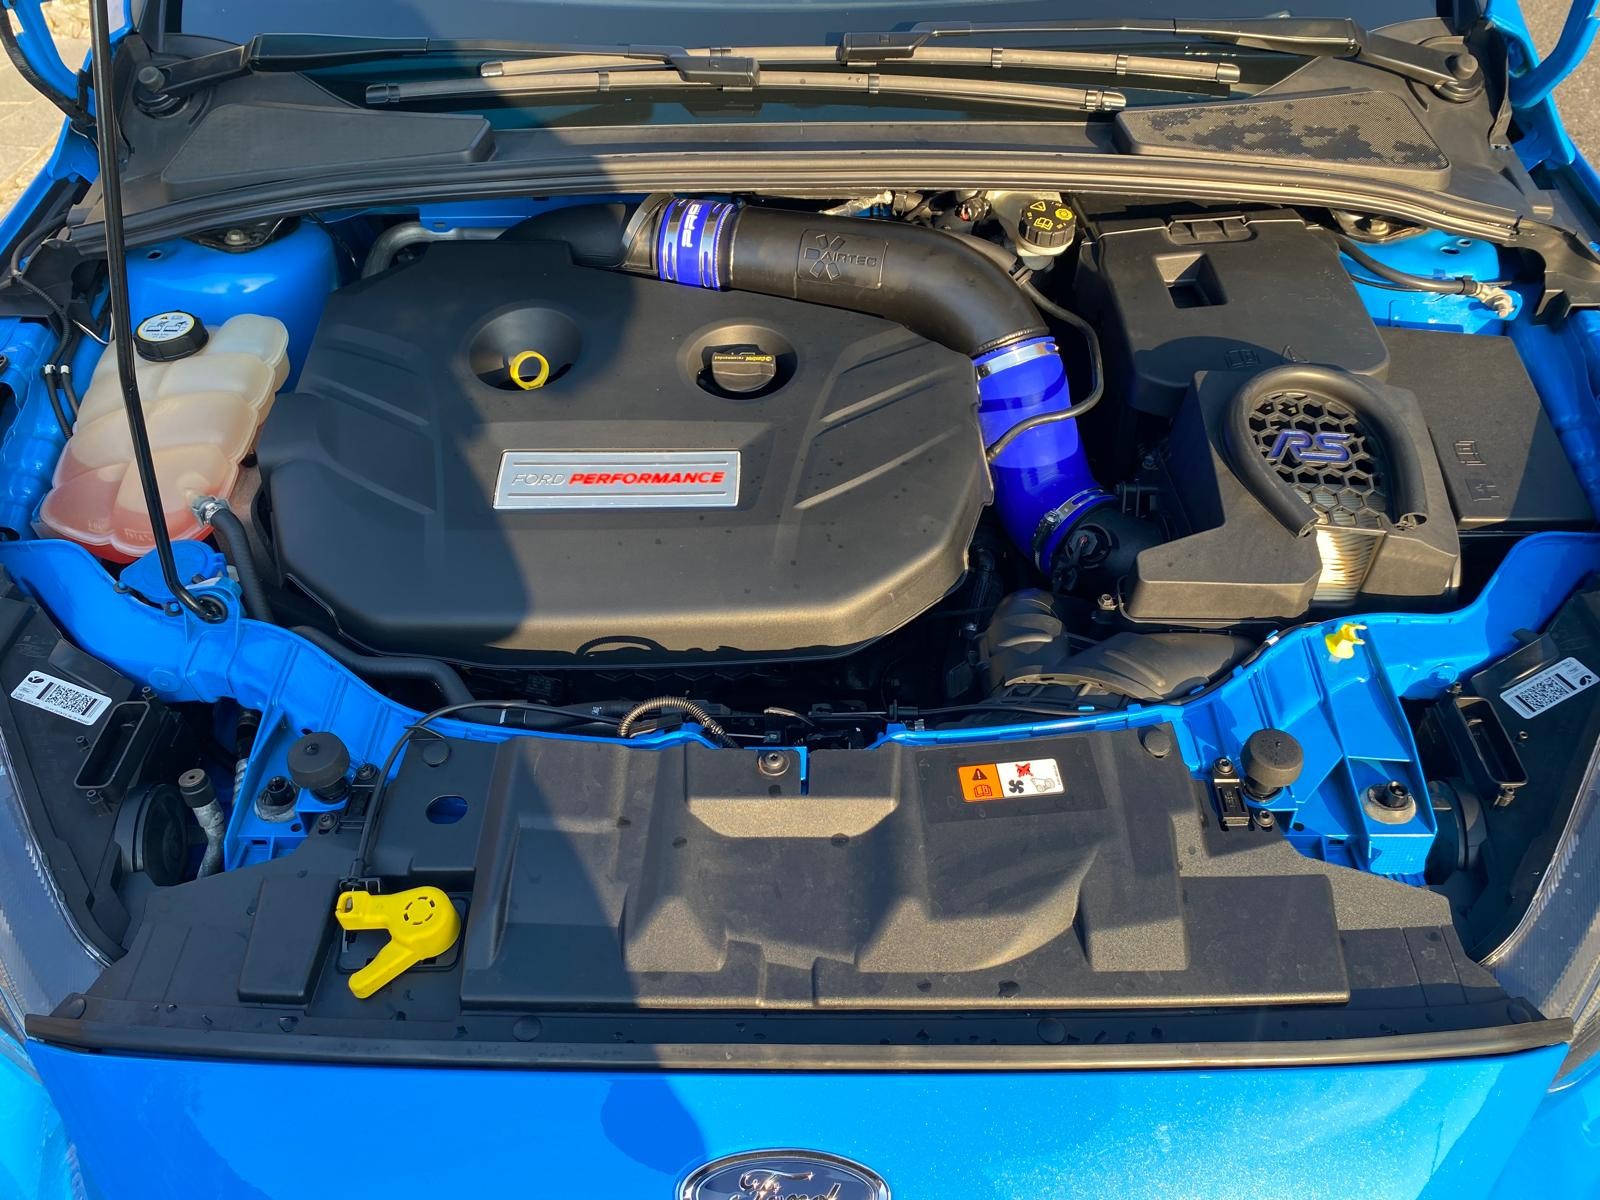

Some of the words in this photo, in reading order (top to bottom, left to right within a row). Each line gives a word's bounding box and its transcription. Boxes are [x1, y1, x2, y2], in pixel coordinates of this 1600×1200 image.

[820, 250, 878, 267] AIRTEC
[1268, 428, 1351, 463] RS
[511, 473, 566, 486] FORD
[568, 471, 725, 486] PERFORMANCE
